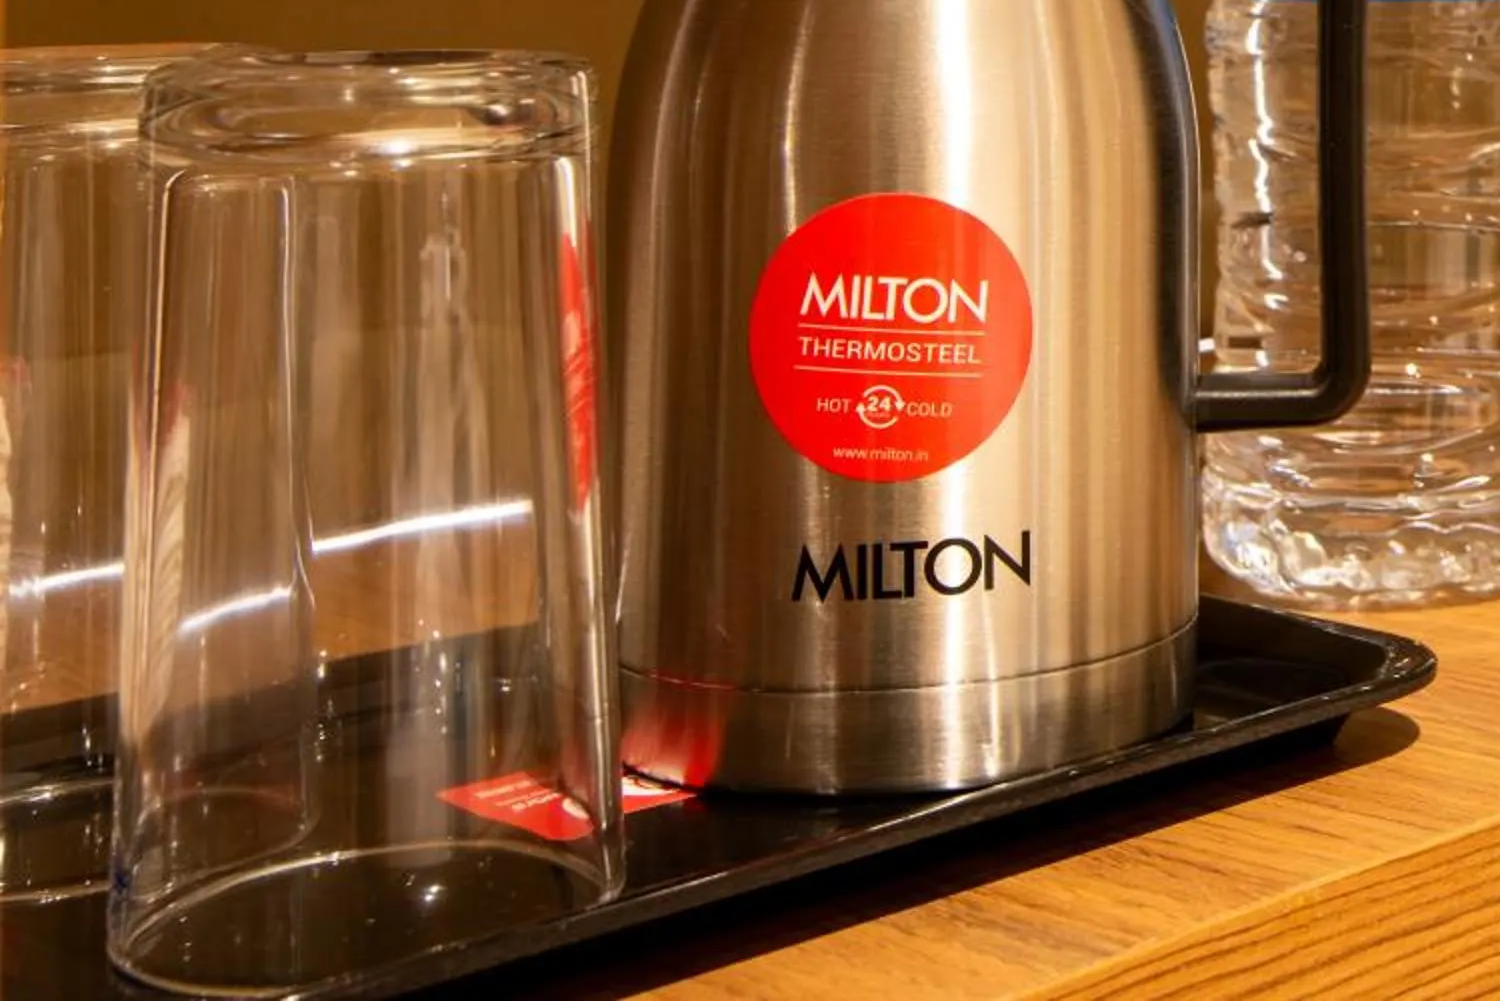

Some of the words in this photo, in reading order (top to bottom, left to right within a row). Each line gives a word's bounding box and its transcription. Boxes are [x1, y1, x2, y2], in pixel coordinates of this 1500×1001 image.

[800, 271, 989, 324] MILTON
[799, 335, 982, 366] THERMOSTEEL
[816, 397, 852, 414] HOT
[867, 396, 892, 413] 24
[906, 401, 954, 418] COLD
[833, 446, 929, 463] www.milton.in
[791, 529, 1032, 603] MILTON
